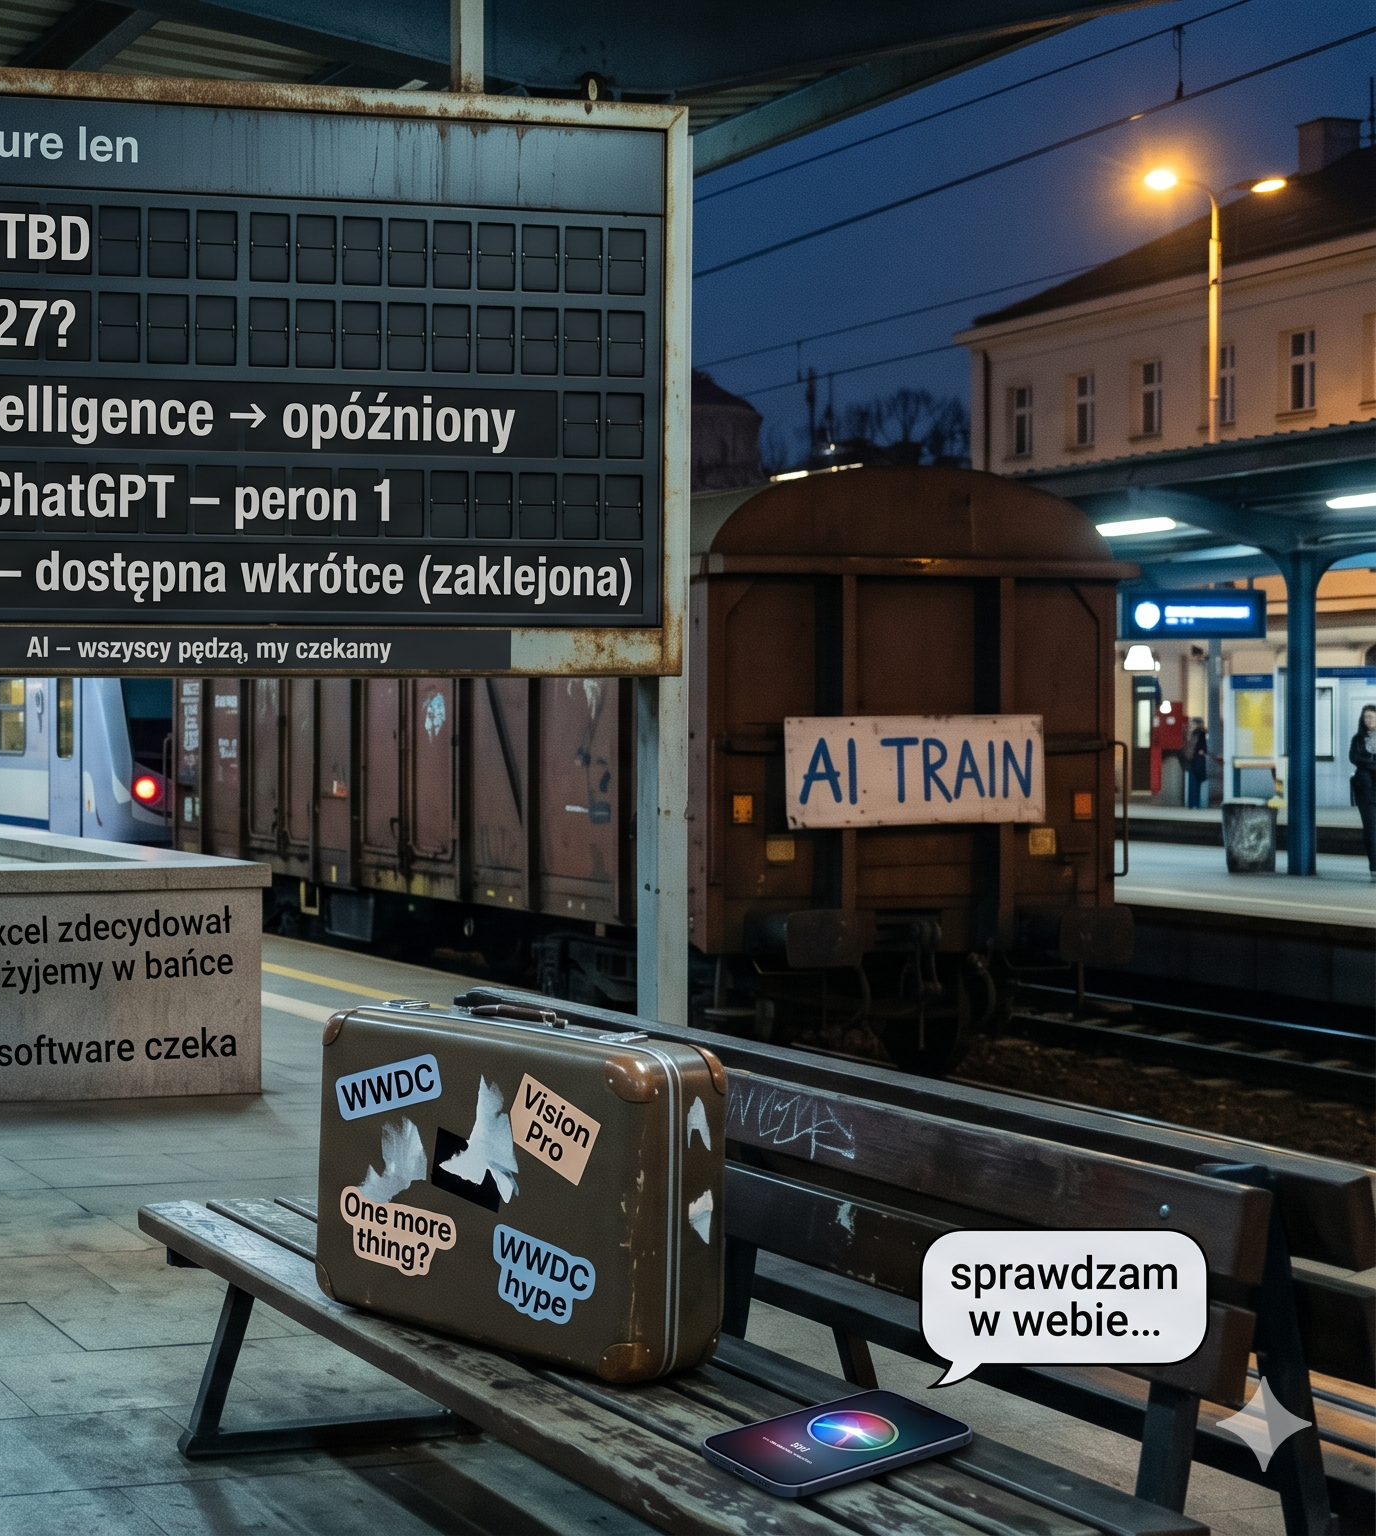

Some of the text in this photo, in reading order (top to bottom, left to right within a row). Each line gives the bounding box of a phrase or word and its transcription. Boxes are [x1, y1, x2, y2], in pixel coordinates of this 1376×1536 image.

[78, 125, 139, 164] len
[282, 391, 516, 454] opóźniony
[235, 486, 357, 530] peron
[373, 478, 390, 522] 1
[35, 550, 227, 603] dostępna
[240, 552, 404, 595] wkrótce
[418, 554, 632, 606] (zaklejona)
[26, 636, 49, 658] AI
[77, 641, 172, 663] wszyscy
[178, 636, 249, 665] pędzą,
[256, 641, 290, 664] my
[295, 637, 392, 664] czekamy
[798, 736, 1033, 806] AI TRAIN
[57, 904, 233, 947] zdecydował
[1, 947, 234, 995] żyjemy w bańce
[144, 1026, 237, 1061] czeka
[341, 1063, 435, 1112] WWDC
[524, 1083, 590, 1149] Vision
[525, 1120, 563, 1162] Pro
[344, 1192, 452, 1242] One more
[357, 1228, 430, 1270] thing?
[499, 1231, 590, 1292] WWDC
[505, 1269, 567, 1317] hype
